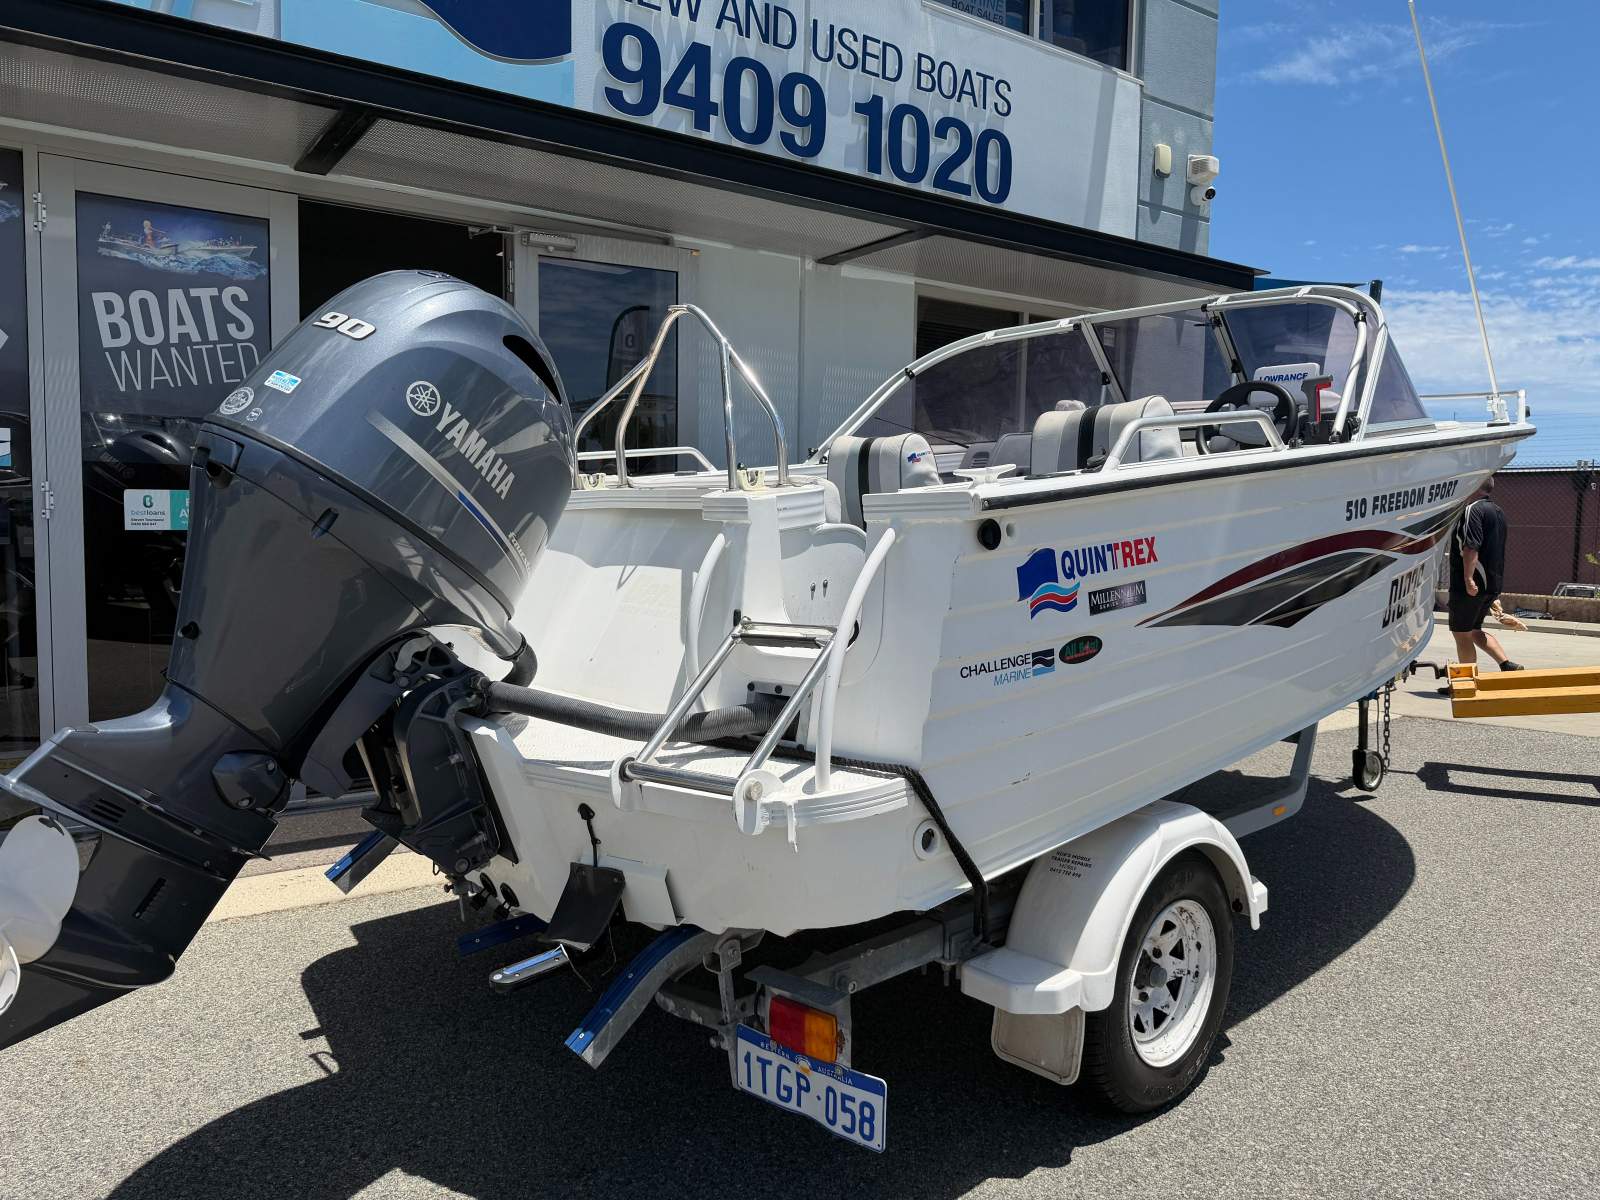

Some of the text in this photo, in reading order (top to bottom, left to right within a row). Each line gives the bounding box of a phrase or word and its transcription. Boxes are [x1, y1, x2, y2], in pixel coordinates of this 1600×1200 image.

[952, 0, 1004, 25] BOAT SALES
[715, 0, 1012, 118] AND USED BOATS
[602, 22, 1013, 204] 9409 1020
[92, 286, 254, 348] BOATS
[312, 311, 376, 340] 90
[105, 342, 260, 392] WANTED
[435, 401, 515, 500] YAMAHA
[1345, 480, 1459, 521] 510 FREEDOM SPORT
[1061, 536, 1158, 580] QUINTREX
[960, 653, 1031, 679] CHALLENGE
[994, 667, 1032, 687] MARINE
